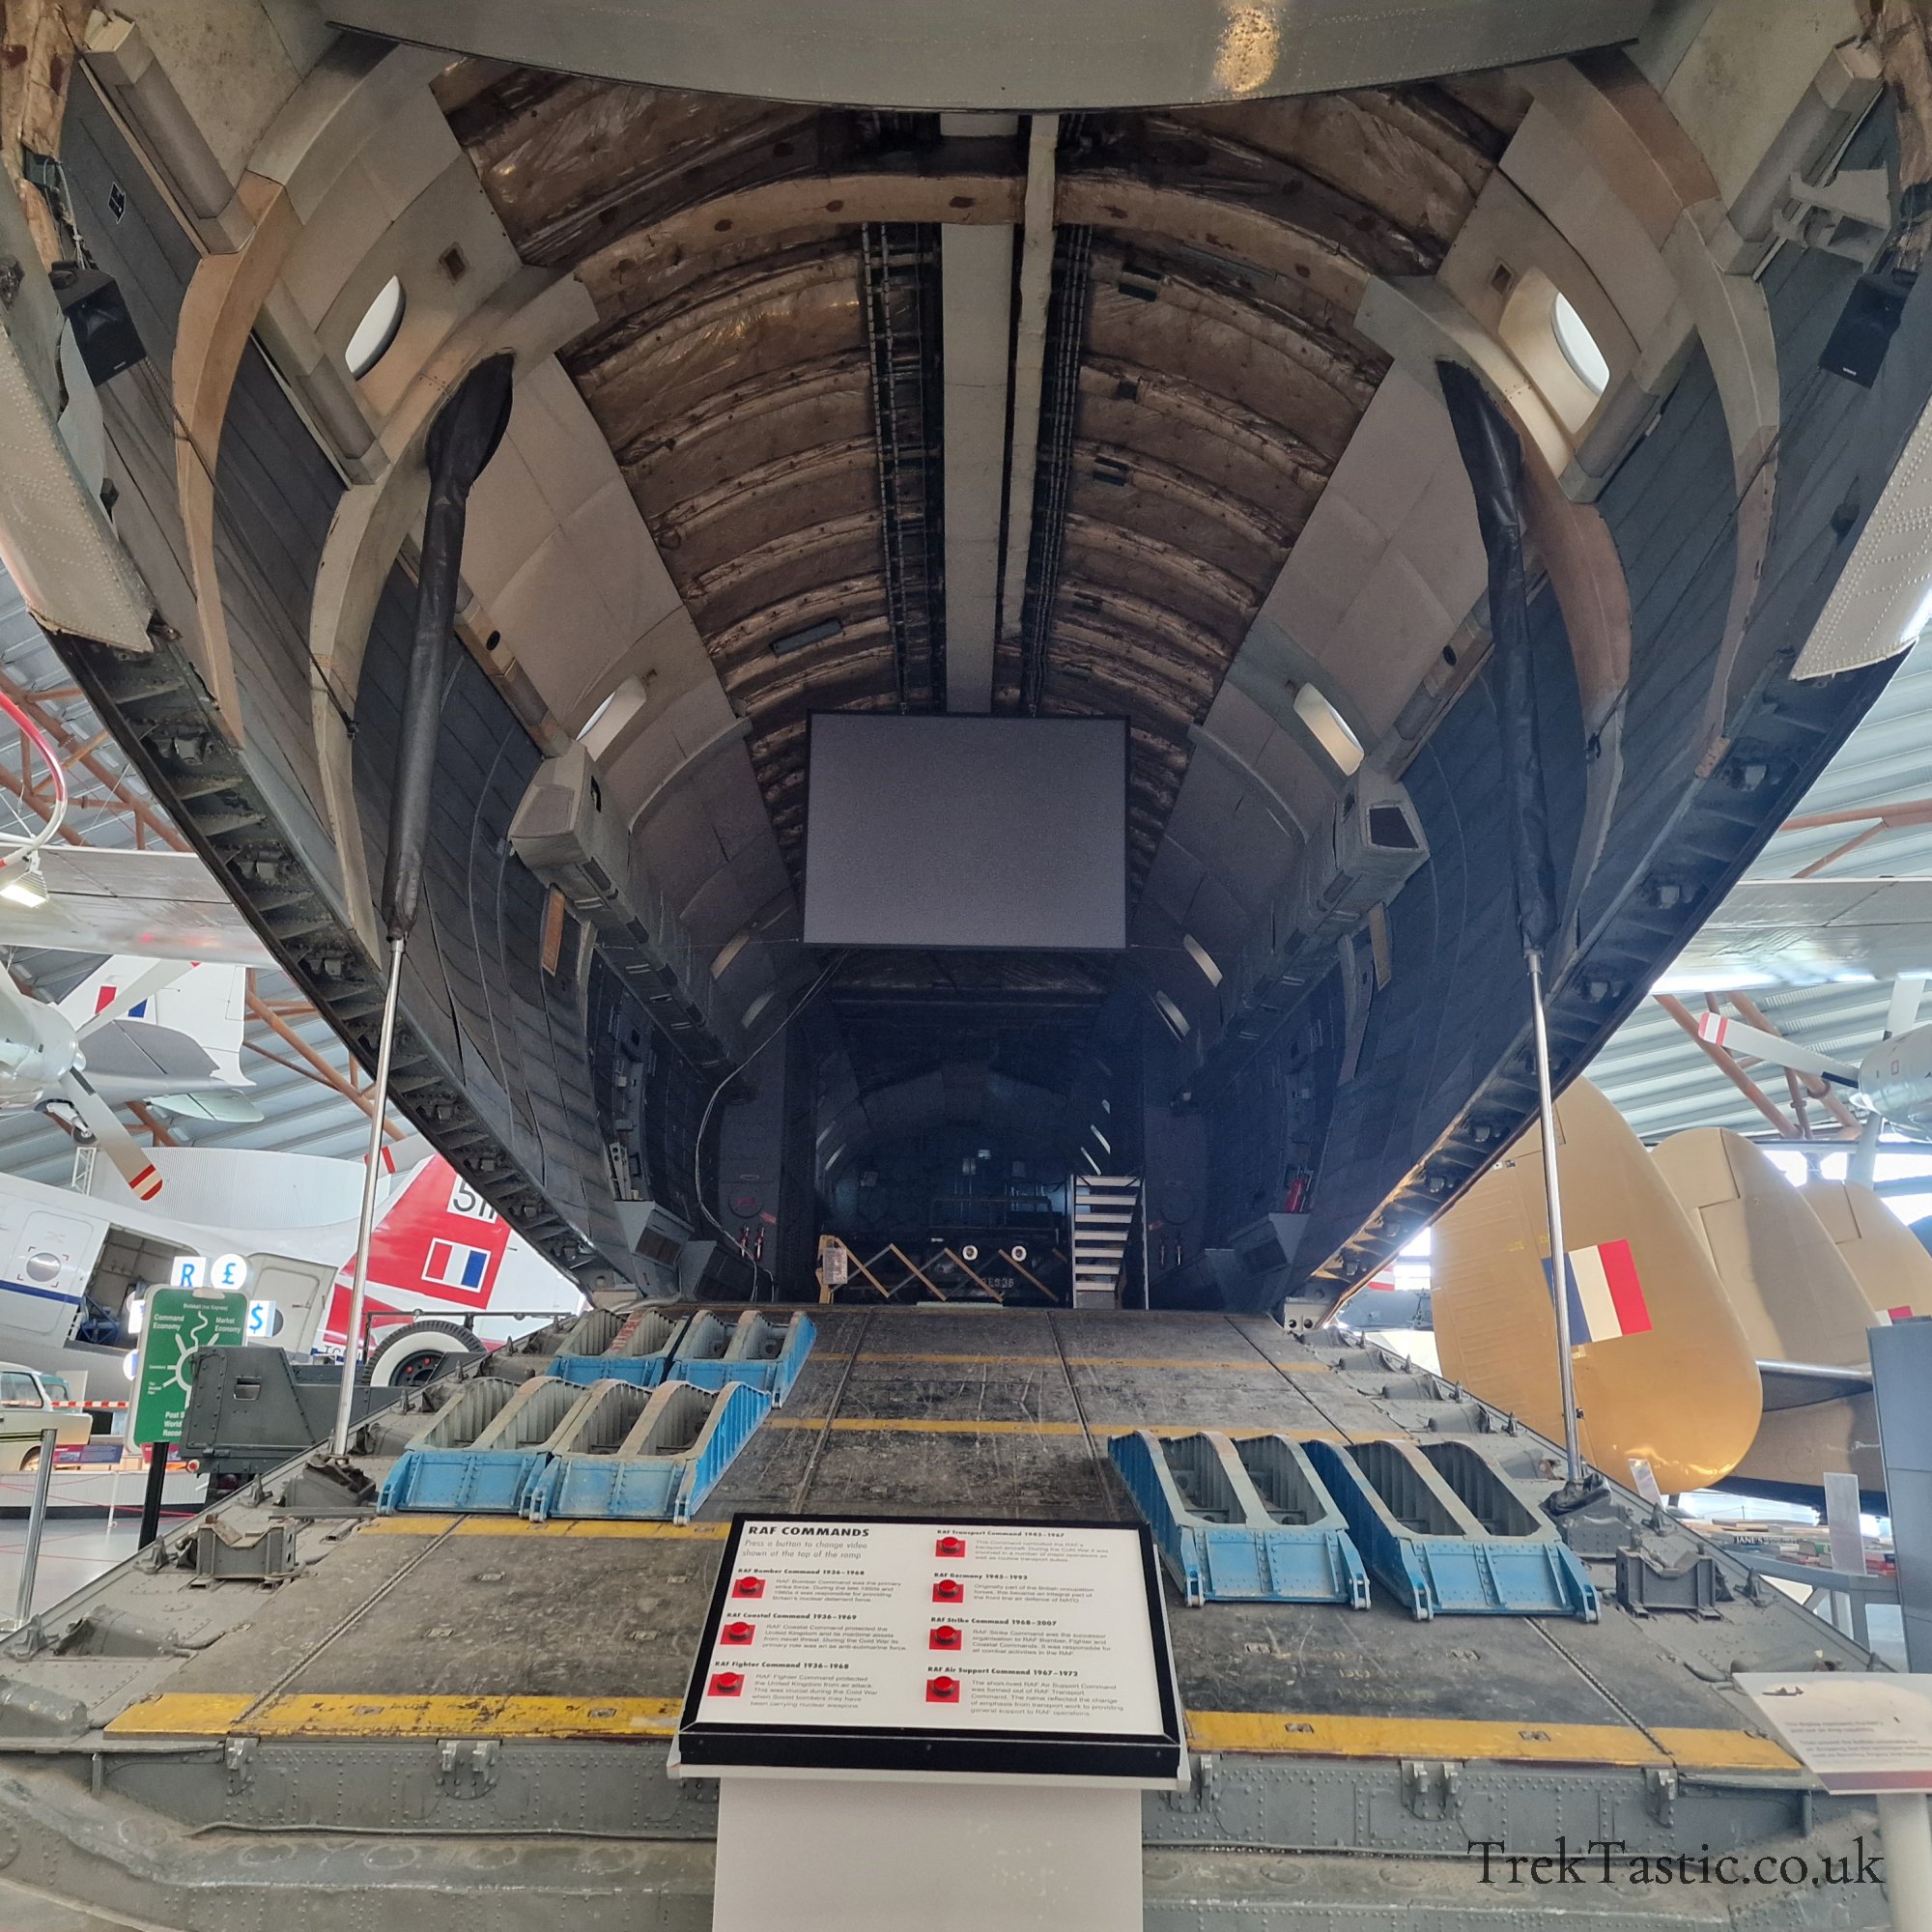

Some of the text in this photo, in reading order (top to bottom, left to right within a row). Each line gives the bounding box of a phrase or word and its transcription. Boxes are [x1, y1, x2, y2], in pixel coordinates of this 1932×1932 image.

[180, 1264, 195, 1287] R
[222, 1263, 236, 1285] £
[154, 1314, 185, 1322] Command
[215, 1317, 236, 1325] Market
[249, 1303, 263, 1333] $
[153, 1322, 181, 1332] Economy
[214, 1325, 242, 1334] Economy
[748, 1526, 870, 1537] RAF COMMANDS
[815, 1541, 844, 1550] change
[797, 1551, 811, 1559] top
[958, 1667, 989, 1675] Support
